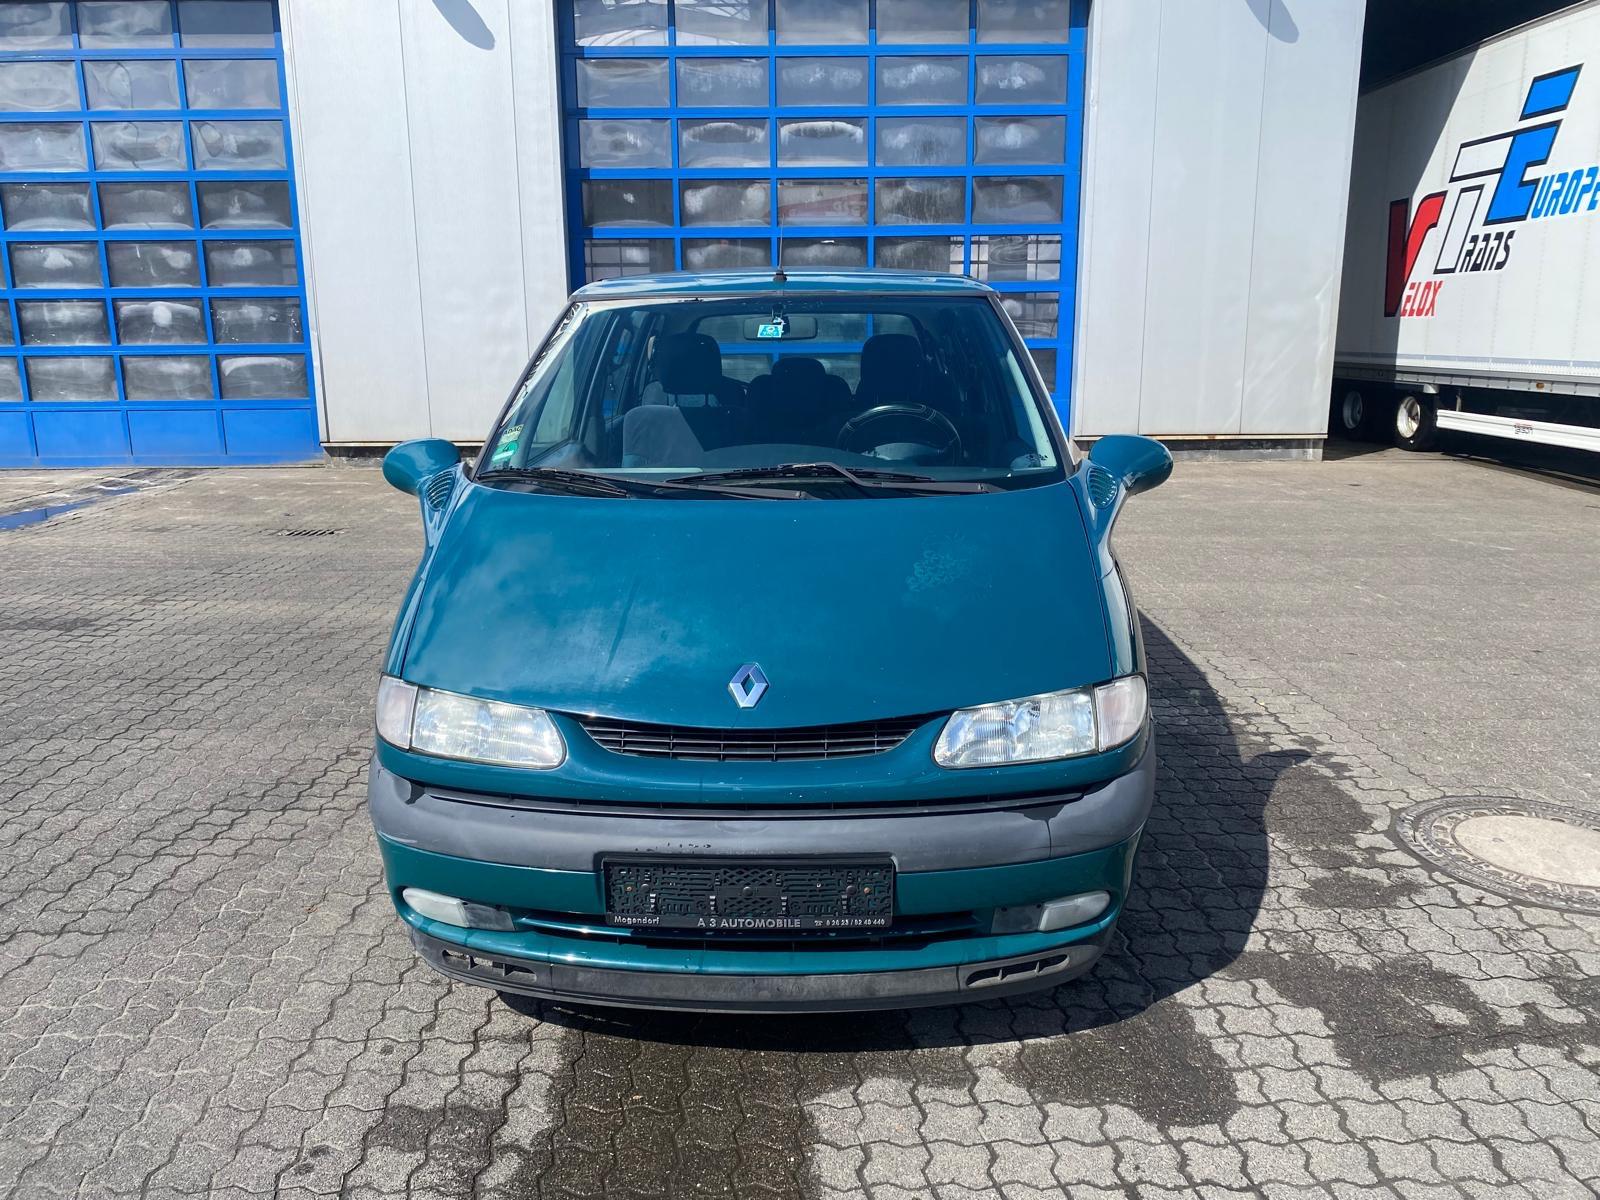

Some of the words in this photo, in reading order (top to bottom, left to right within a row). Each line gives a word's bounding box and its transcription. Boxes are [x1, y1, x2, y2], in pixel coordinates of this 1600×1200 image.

[614, 916, 659, 925] Mogendorf
[697, 918, 706, 927] A
[709, 918, 716, 927] 3
[720, 918, 801, 928] AUTOMOBILE
